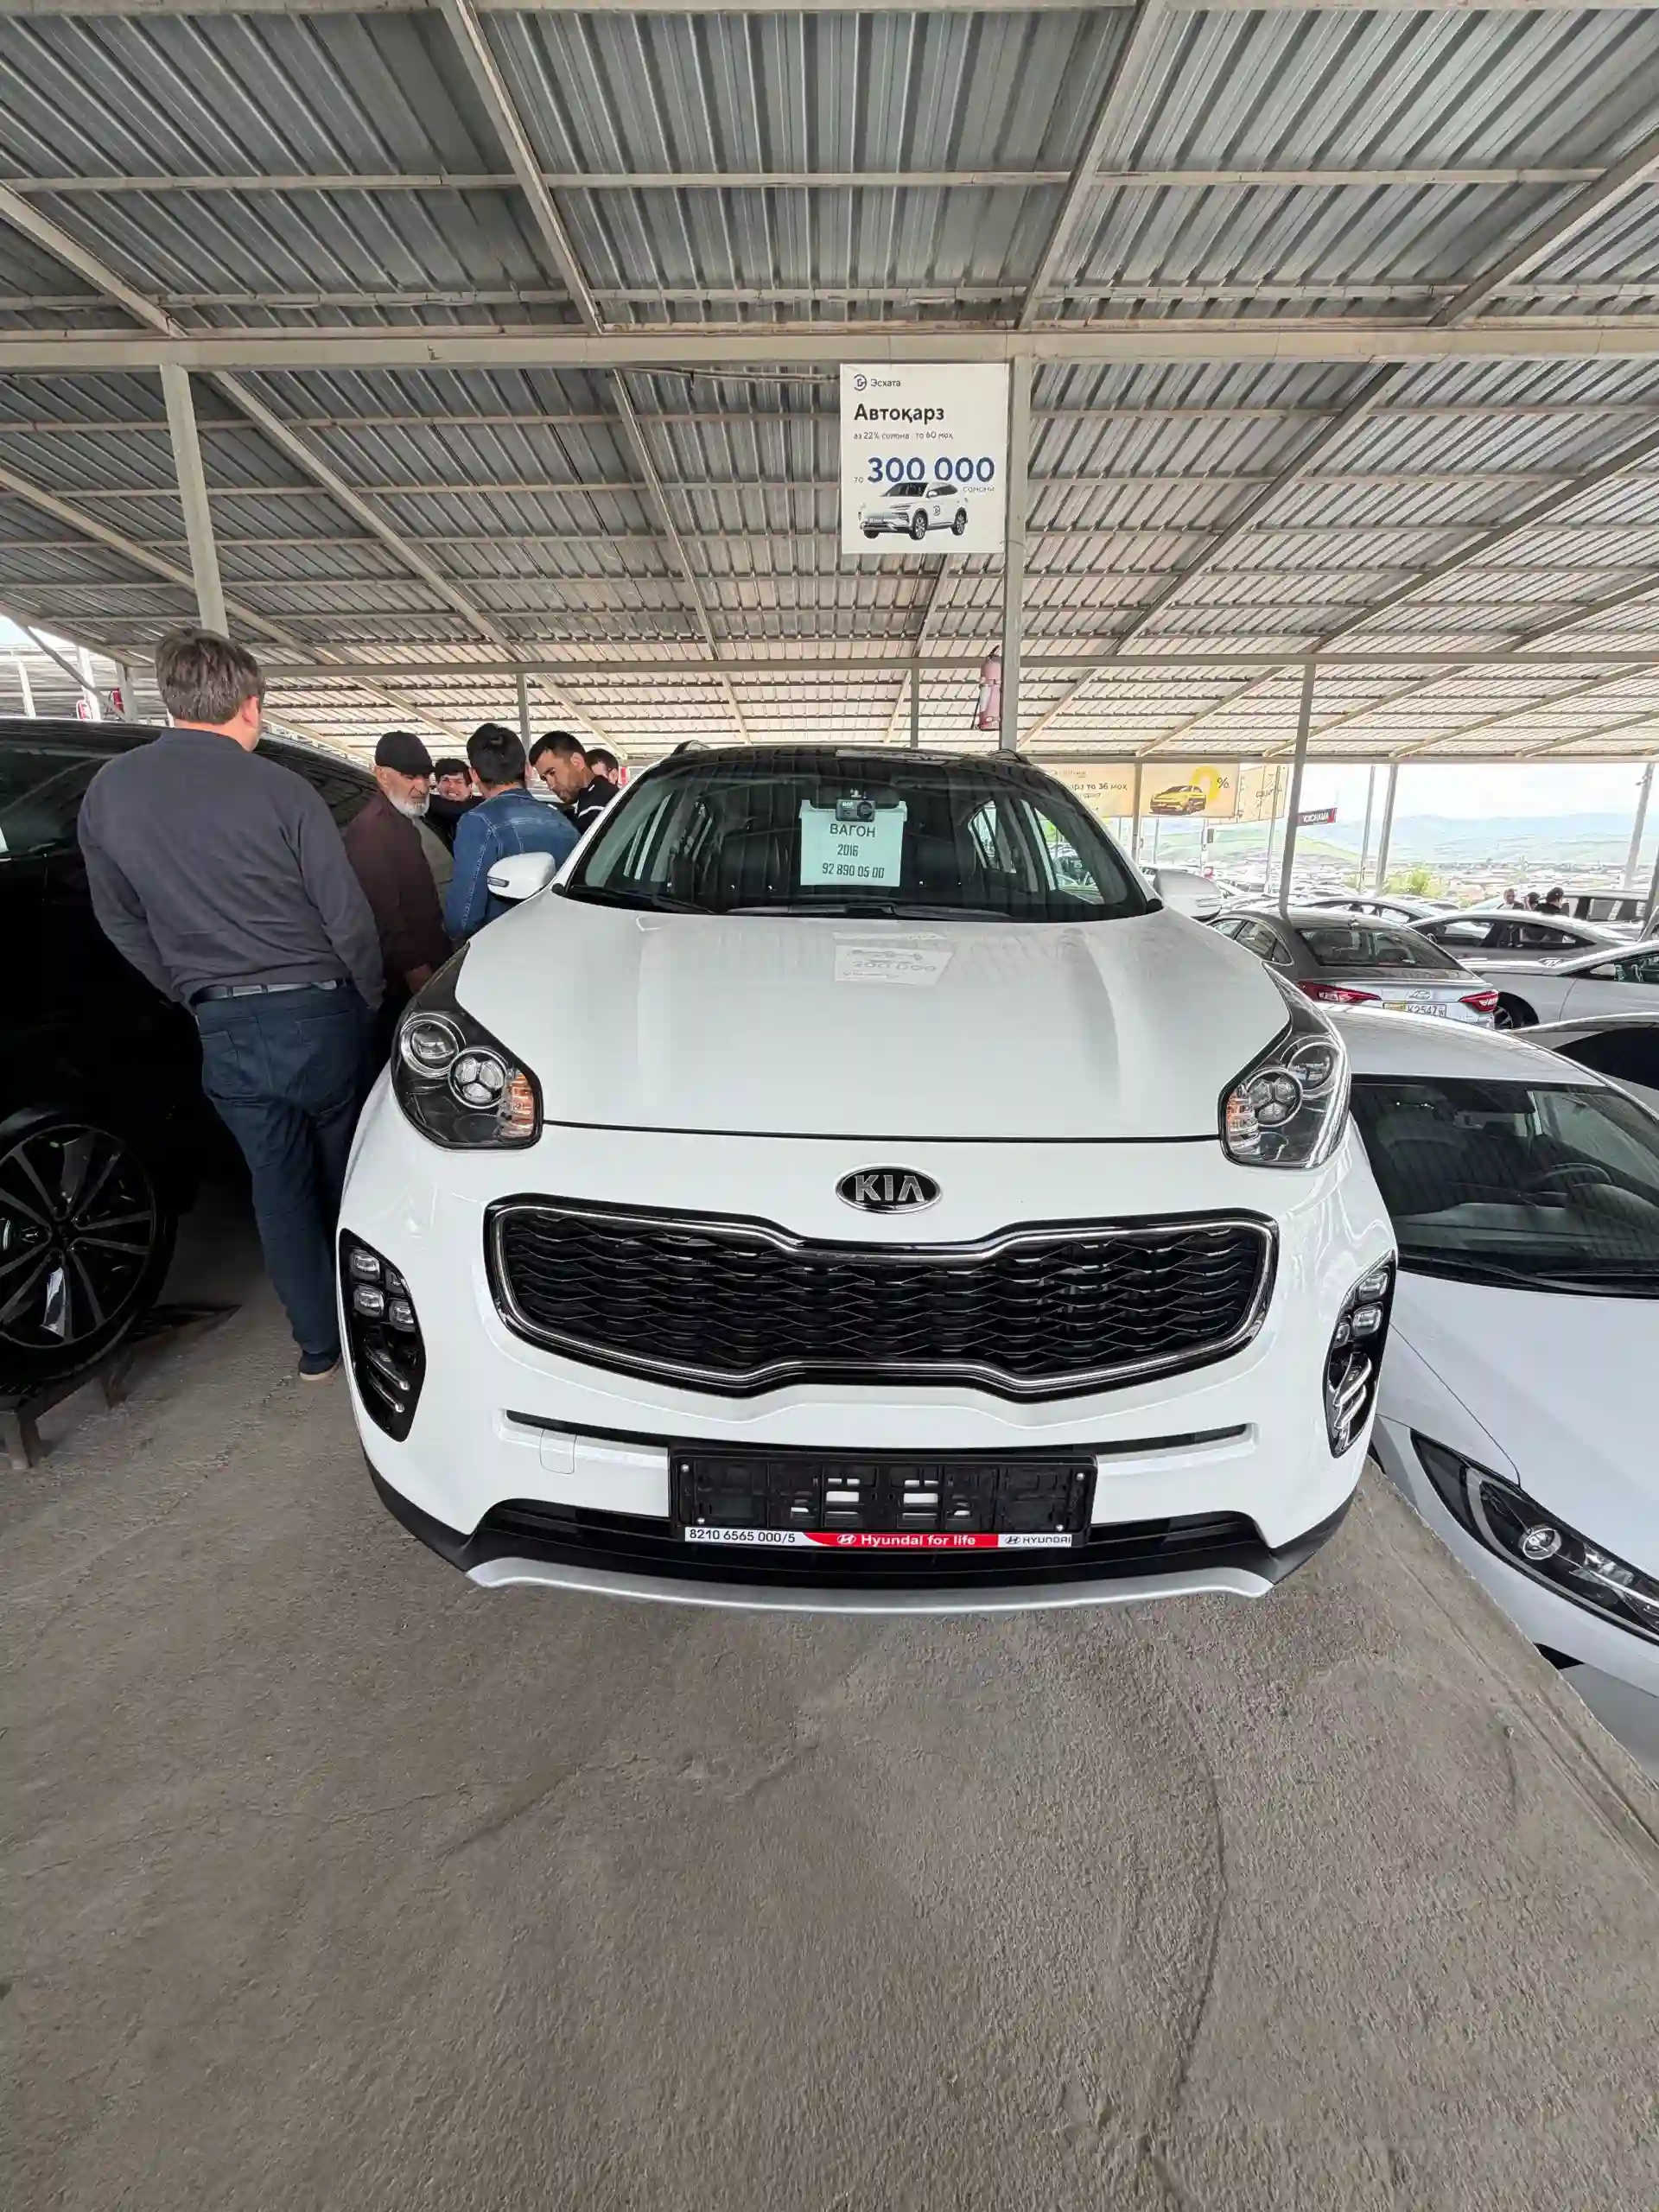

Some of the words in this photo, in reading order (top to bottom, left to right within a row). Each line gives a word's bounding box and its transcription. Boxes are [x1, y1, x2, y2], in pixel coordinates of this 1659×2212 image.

[870, 378, 901, 388] Эсхата
[854, 403, 944, 425] Автоқарз
[868, 456, 925, 483] 300
[934, 456, 995, 483] 000
[830, 823, 876, 838] ВАГОН
[837, 843, 859, 857] 2016
[822, 862, 835, 875] 92
[836, 863, 855, 876] 890
[857, 865, 870, 878] 05
[872, 867, 885, 879] 00
[855, 1174, 925, 1201] KIA
[689, 1529, 720, 1540] 8210
[723, 1529, 754, 1541] 6565
[758, 1531, 795, 1543] 000/5
[861, 1534, 923, 1548] Hyundai
[927, 1534, 949, 1546] for
[954, 1534, 976, 1546] life
